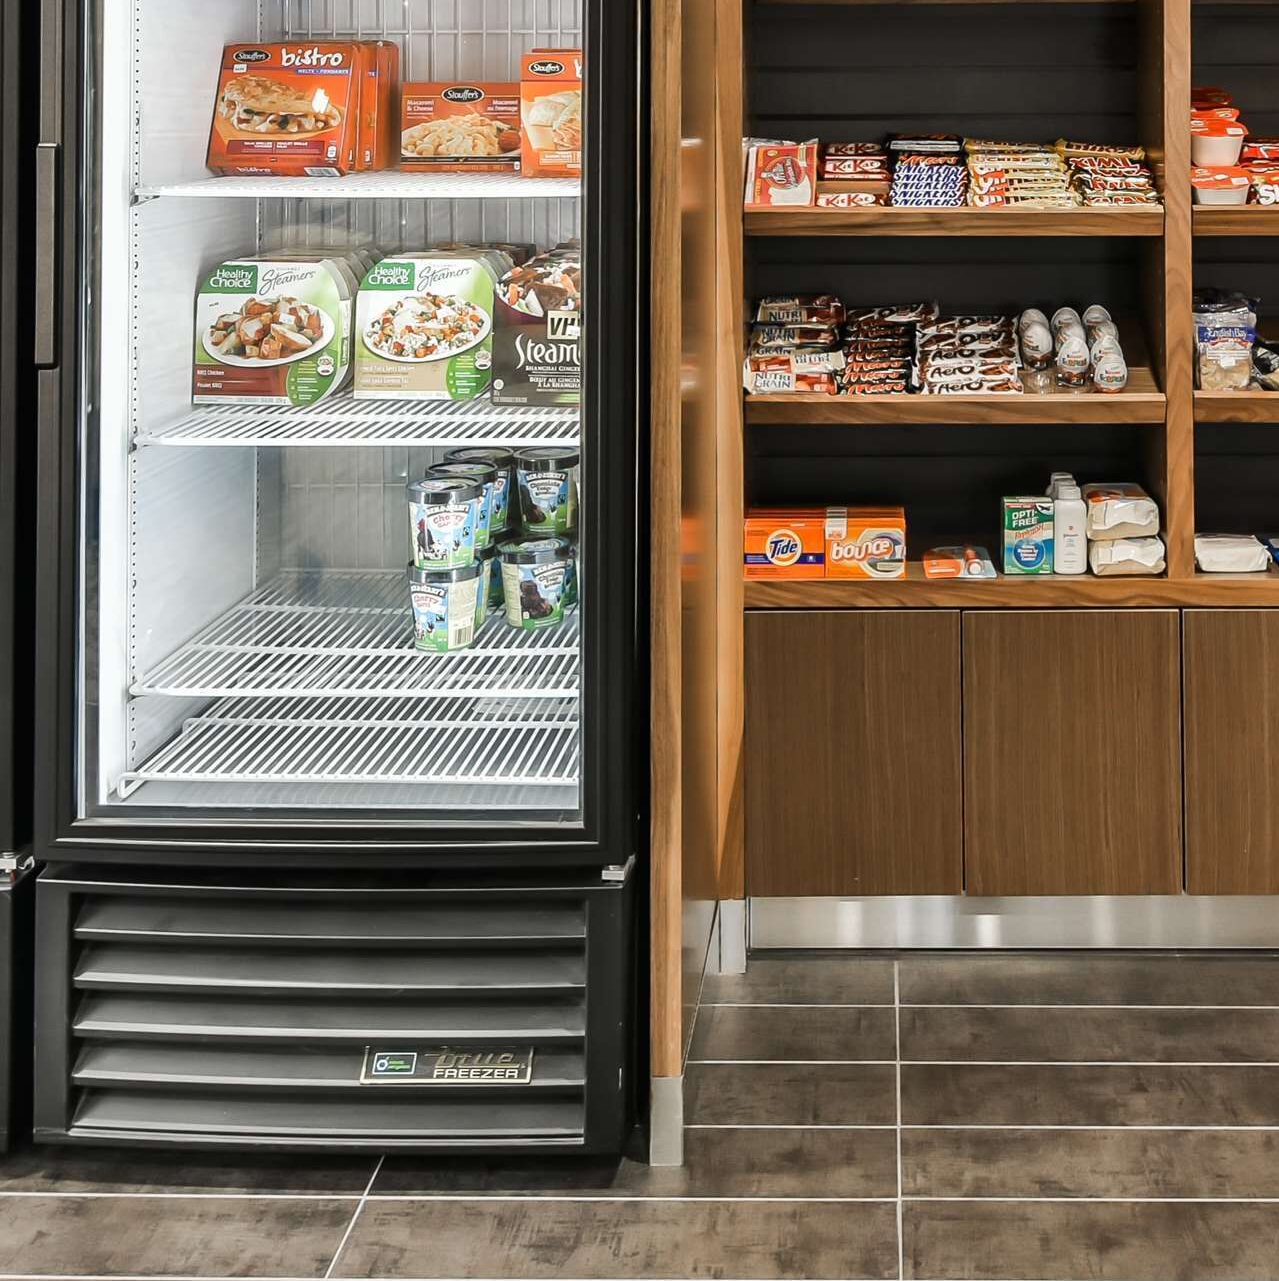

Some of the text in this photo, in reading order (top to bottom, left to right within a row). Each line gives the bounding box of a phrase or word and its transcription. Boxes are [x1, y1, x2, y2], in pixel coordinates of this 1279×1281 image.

[280, 47, 344, 67] bistro
[216, 269, 254, 281] Healthy
[375, 266, 410, 277] Healthy
[209, 277, 252, 288] Choice
[259, 268, 316, 296] Steamers
[368, 274, 410, 285] Choice
[417, 265, 470, 292] Steamers
[931, 349, 976, 361] Aero
[754, 372, 792, 380] NUTRI
[930, 365, 975, 378] Aero
[753, 379, 791, 388] GRAIN
[937, 380, 983, 393] Aero
[432, 514, 465, 524] Chey
[1012, 509, 1039, 520] OPTI-
[1012, 518, 1039, 529] FREE
[769, 539, 798, 559] Tide
[831, 539, 891, 561] bounce
[433, 1068, 519, 1079] FREEZER
